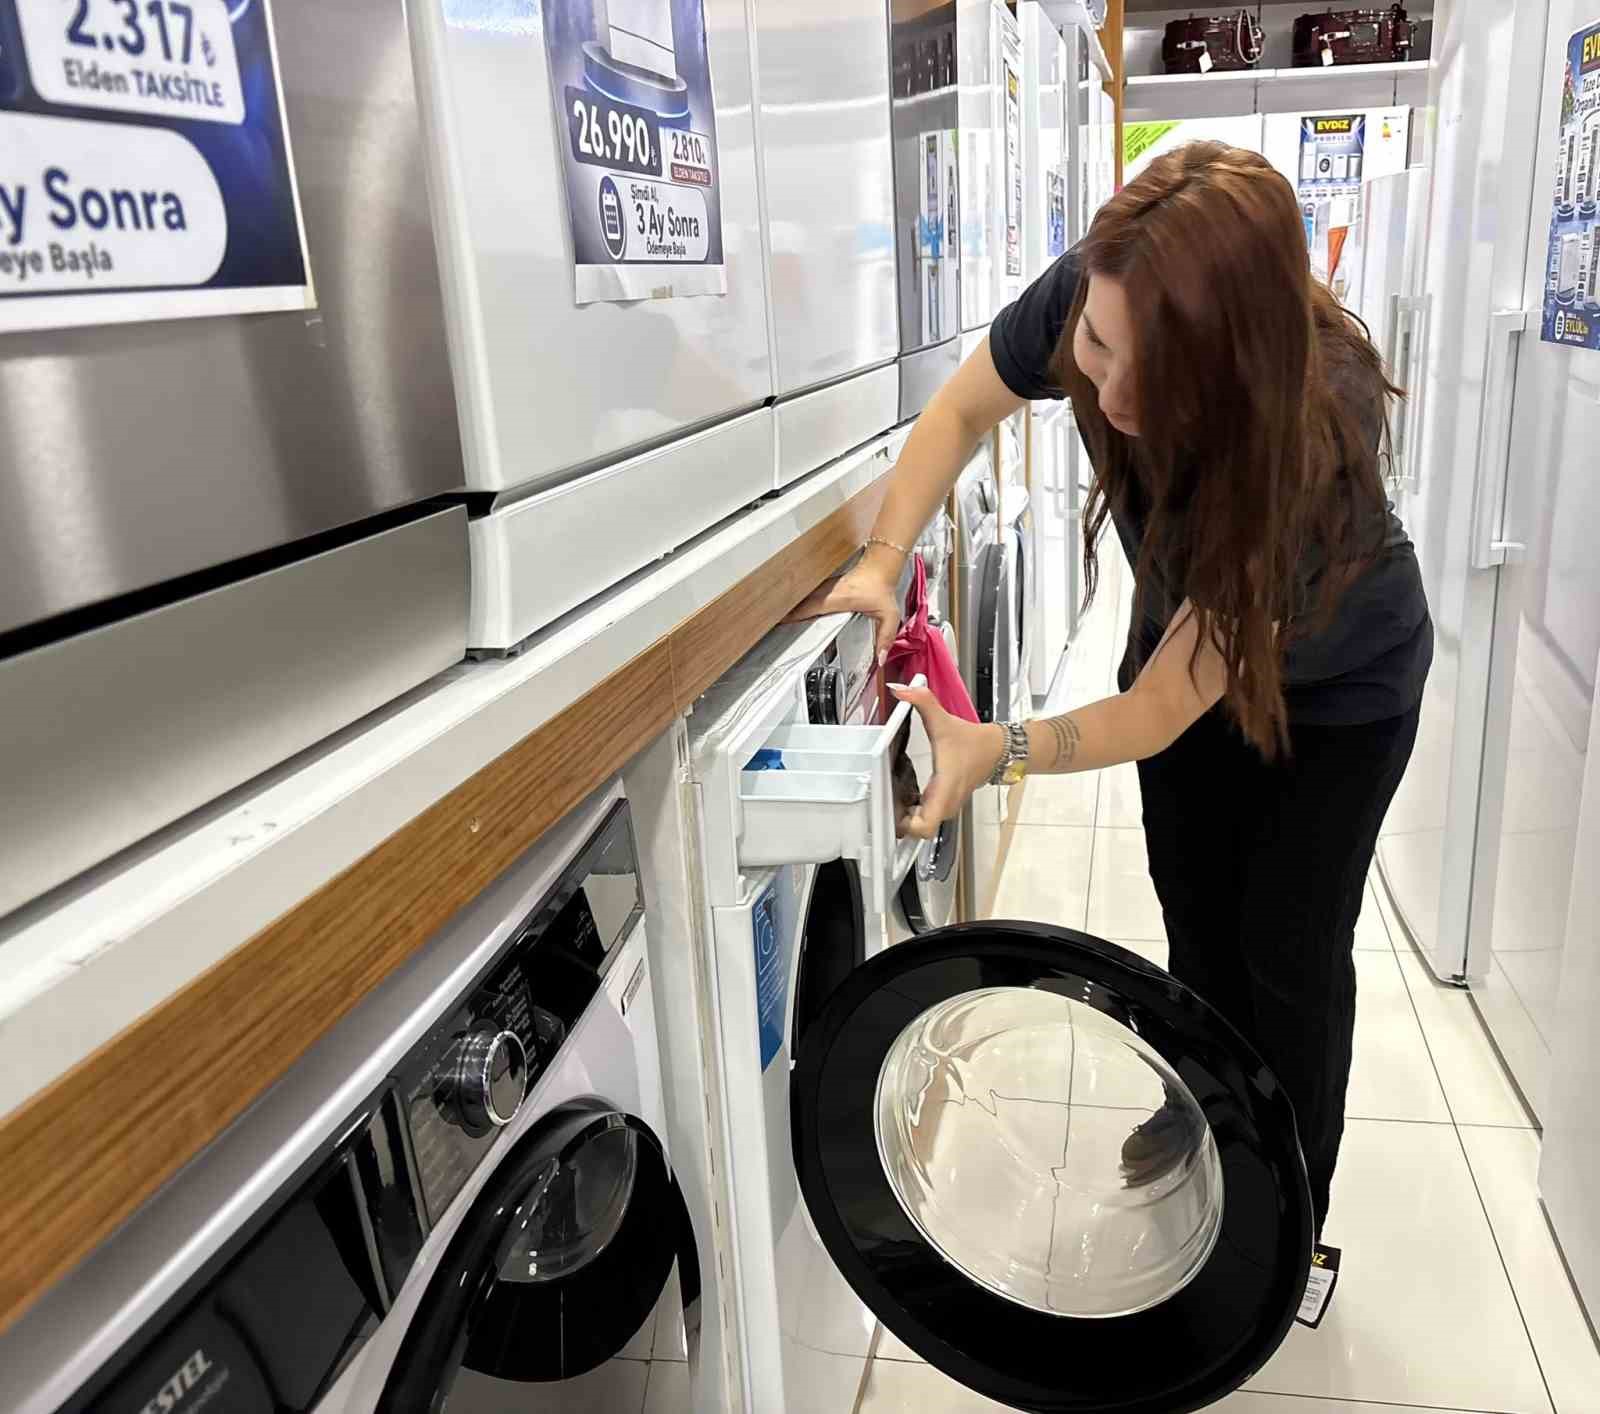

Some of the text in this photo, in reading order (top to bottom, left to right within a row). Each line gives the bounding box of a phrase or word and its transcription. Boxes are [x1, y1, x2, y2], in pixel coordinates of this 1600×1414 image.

[63, 58, 225, 107] Elden TAKSİTLE
[0, 166, 187, 246] y Sonra
[635, 203, 700, 244] 3 Ay Sonra
[48, 242, 114, 279] Başla
